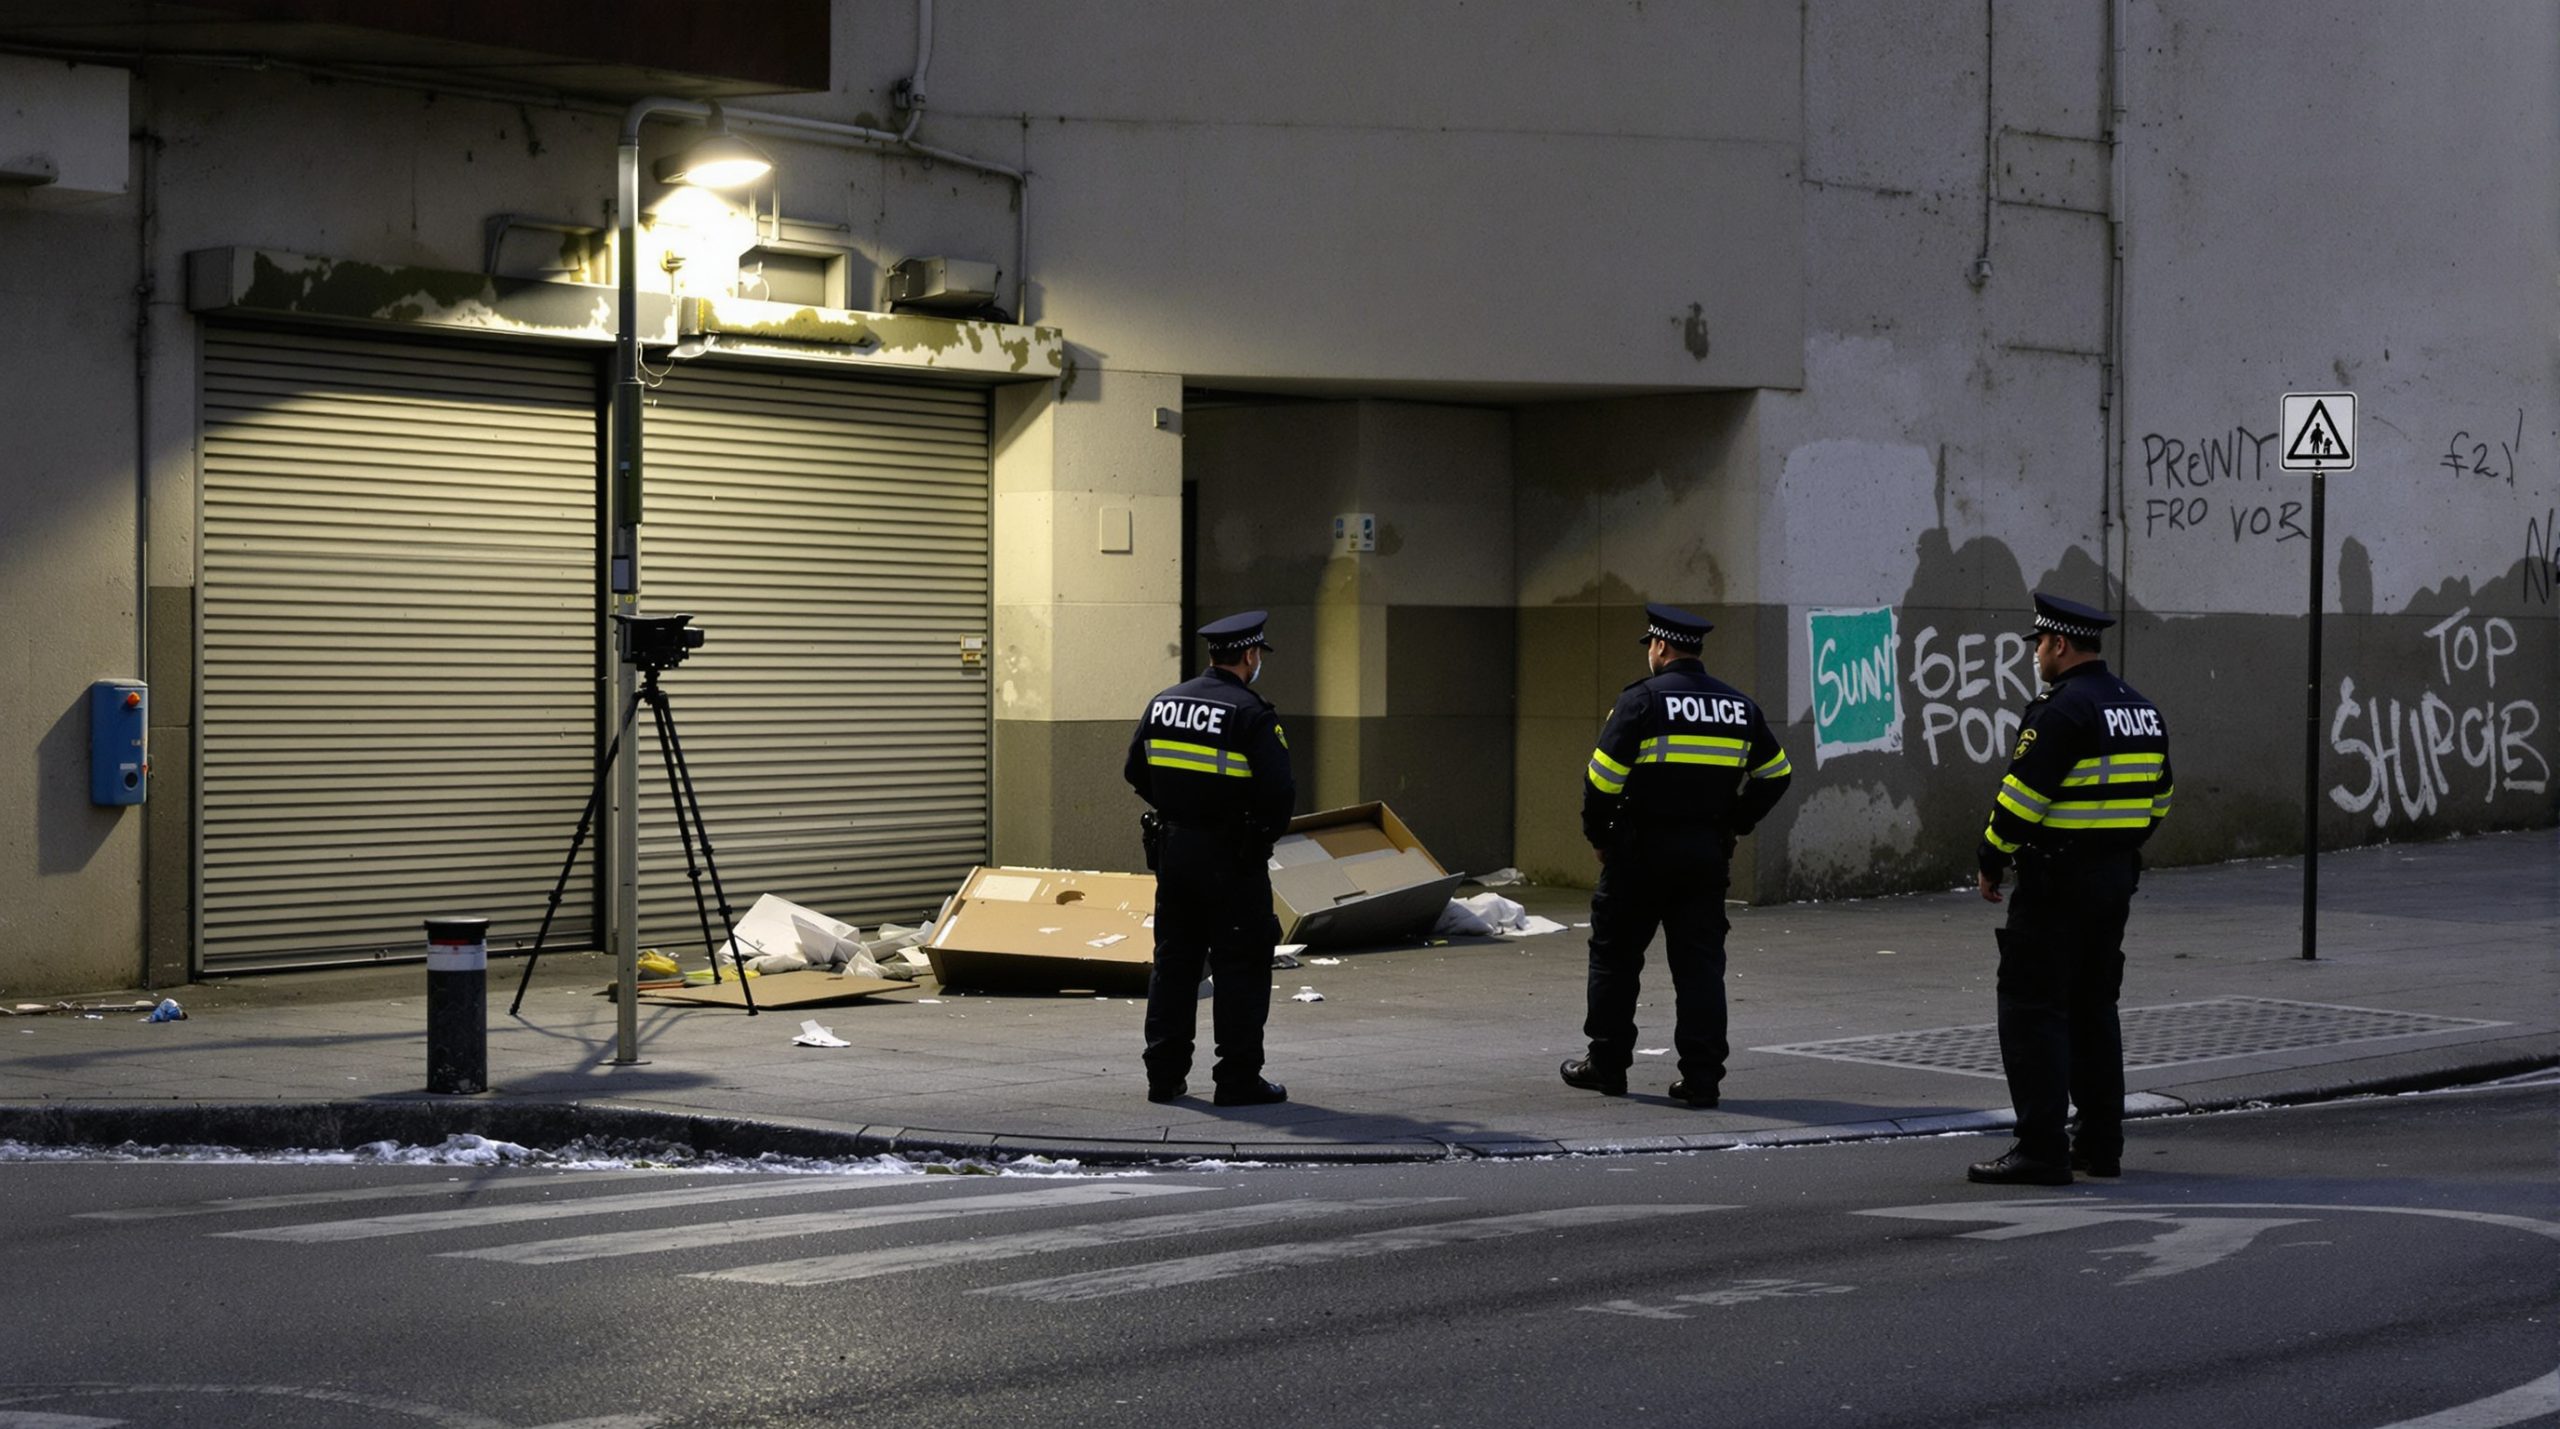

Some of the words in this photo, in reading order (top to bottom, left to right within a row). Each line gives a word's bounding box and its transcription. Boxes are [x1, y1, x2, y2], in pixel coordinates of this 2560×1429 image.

[2146, 497, 2208, 538] FRO
[2424, 606, 2517, 688] TOP
[1150, 701, 1226, 735] POLICE
[1665, 696, 1748, 726] POLICE
[2103, 708, 2162, 737] POLICE
